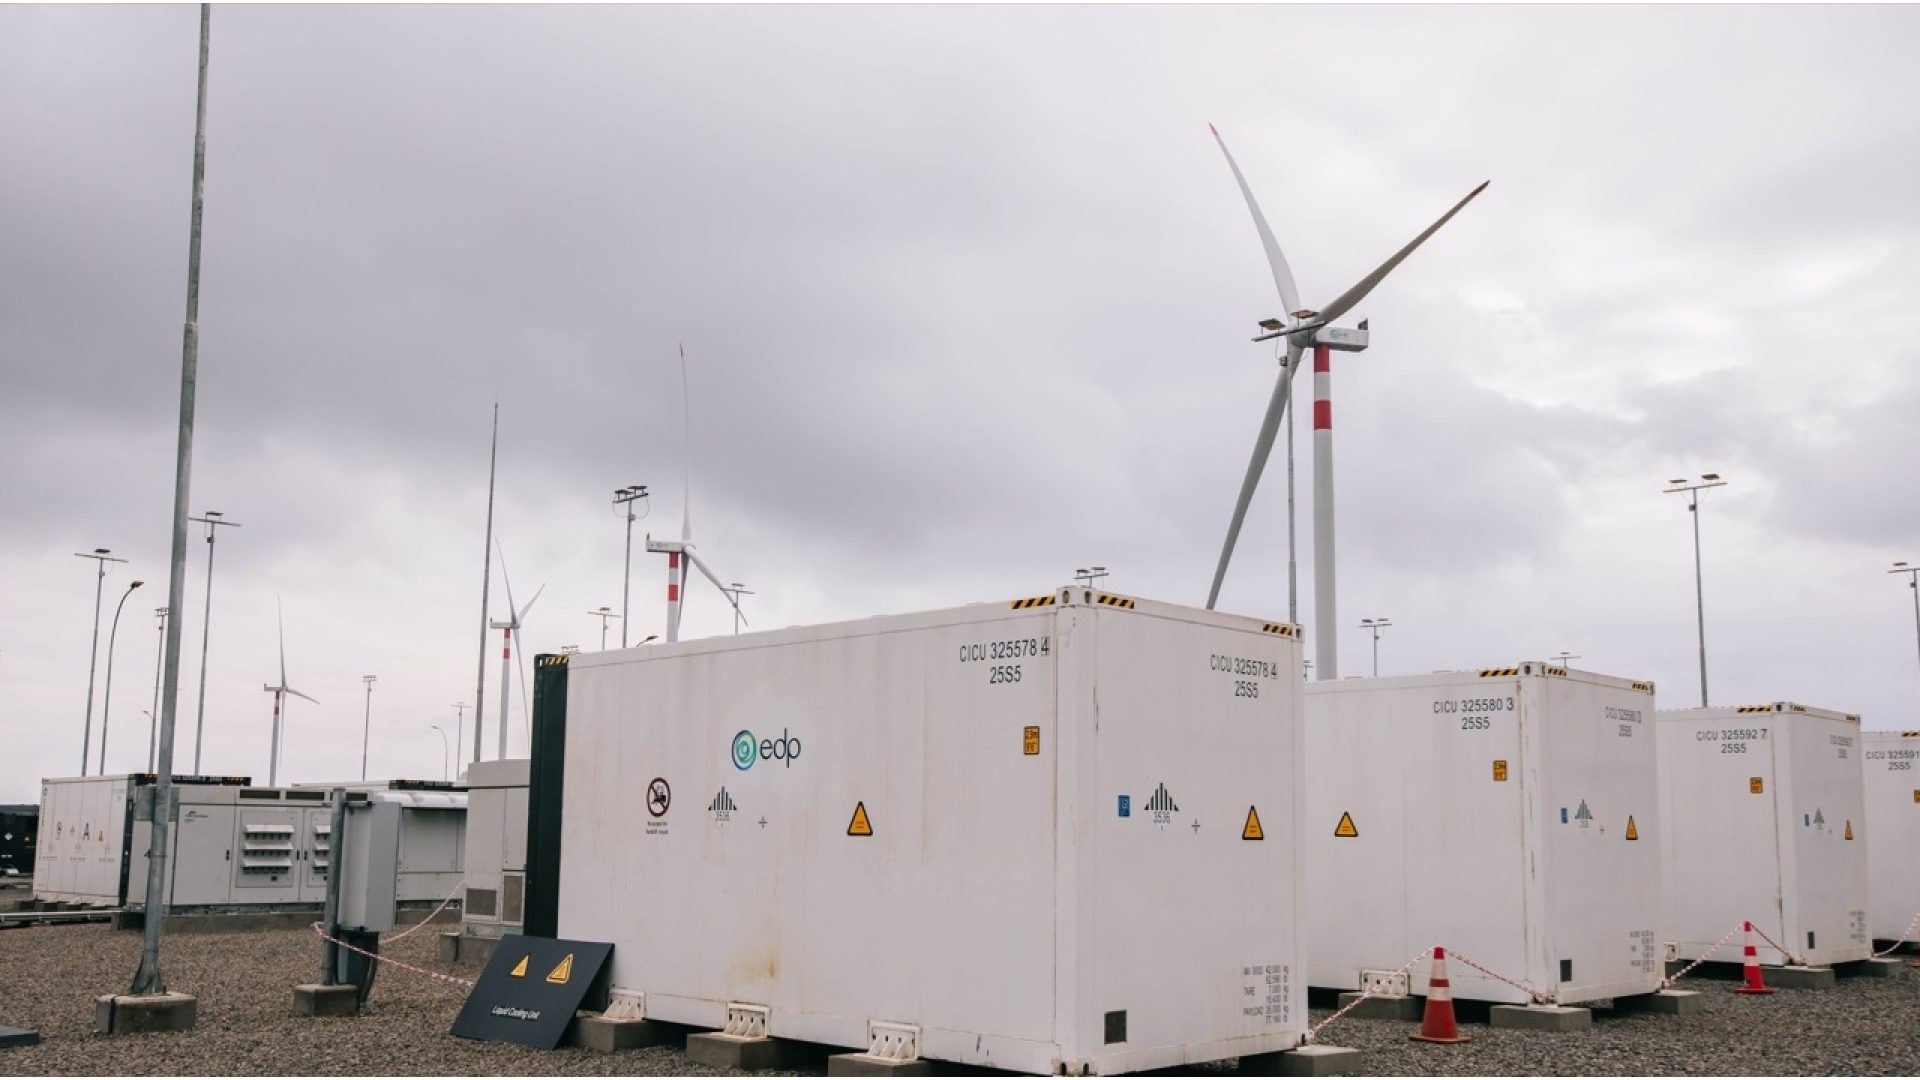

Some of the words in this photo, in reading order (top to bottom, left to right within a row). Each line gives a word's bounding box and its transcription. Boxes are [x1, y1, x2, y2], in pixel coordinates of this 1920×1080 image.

[959, 645, 986, 662] CICU
[990, 639, 1037, 660] 325578
[1041, 637, 1050, 656] 4
[989, 665, 1022, 684] 25S5
[1235, 658, 1268, 677] 325578
[1235, 680, 1258, 698] 25S5
[1433, 701, 1457, 713] CICU
[1461, 698, 1503, 712] 325580
[1460, 717, 1490, 729] 25S5
[1721, 729, 1758, 740] 325592
[760, 727, 801, 768] edp
[1721, 743, 1747, 753] 25S5
